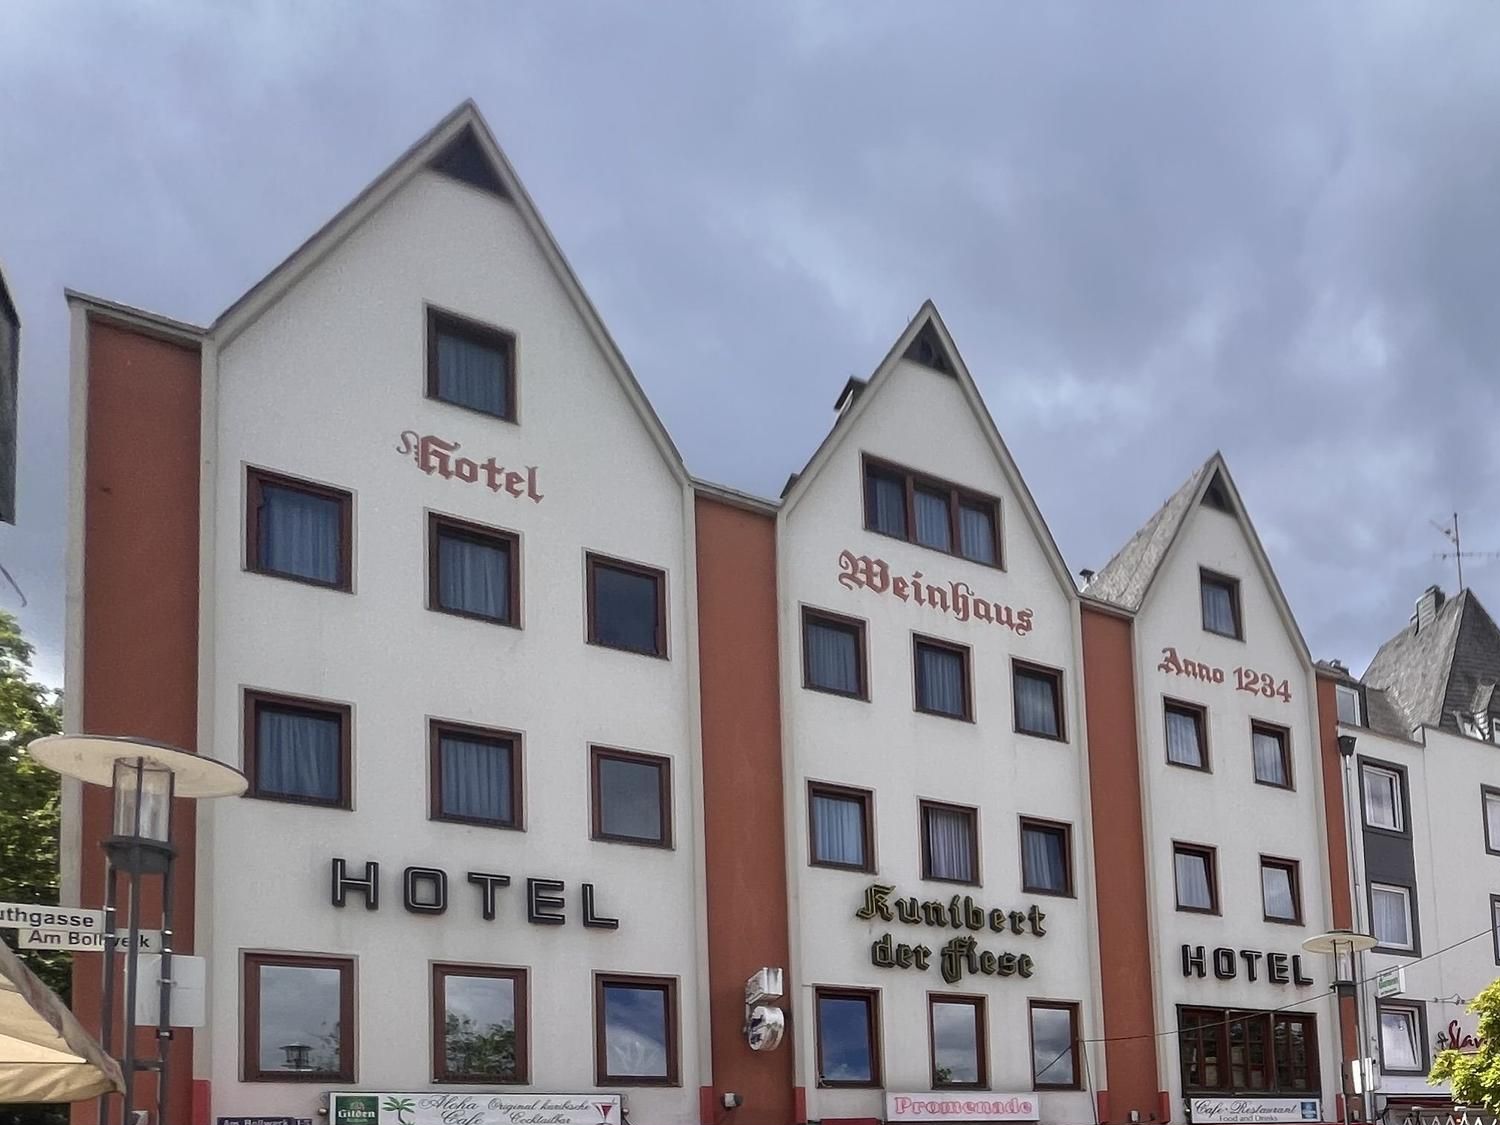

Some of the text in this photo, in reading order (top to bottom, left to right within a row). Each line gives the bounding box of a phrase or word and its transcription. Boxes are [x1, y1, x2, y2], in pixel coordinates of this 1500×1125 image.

[396, 430, 544, 503] Hotel
[838, 549, 1034, 636] Weinhaus
[1158, 647, 1292, 703] Anno 1234
[332, 858, 619, 929] HOTEL
[856, 884, 1047, 937] Kunibert
[28, 930, 61, 944] Am
[871, 933, 1035, 984] der Fiese
[1182, 944, 1314, 985] HOTEL
[338, 1109, 376, 1118] Gilden
[418, 1095, 479, 1110] Aloha
[488, 1097, 536, 1111] Original
[509, 1112, 571, 1125] Cocktailbar
[894, 1096, 1033, 1114] Promenade
